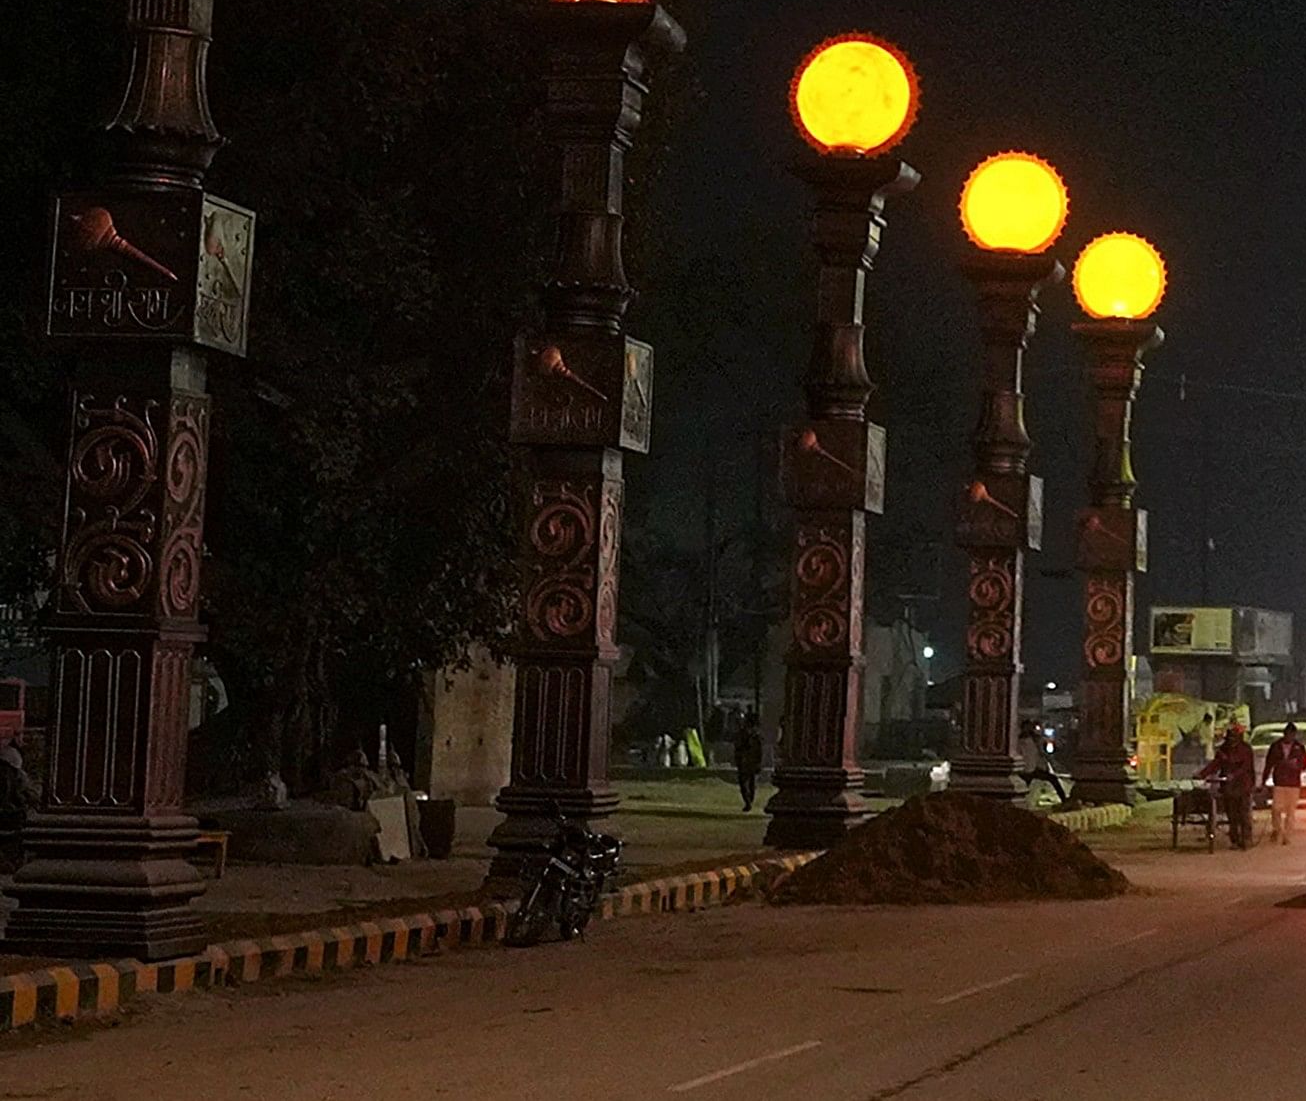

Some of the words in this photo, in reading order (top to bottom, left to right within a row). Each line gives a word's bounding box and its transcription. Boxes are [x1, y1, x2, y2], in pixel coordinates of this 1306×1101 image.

[53, 287, 92, 319] जय
[100, 269, 128, 327] श्री
[127, 287, 186, 330] राम
